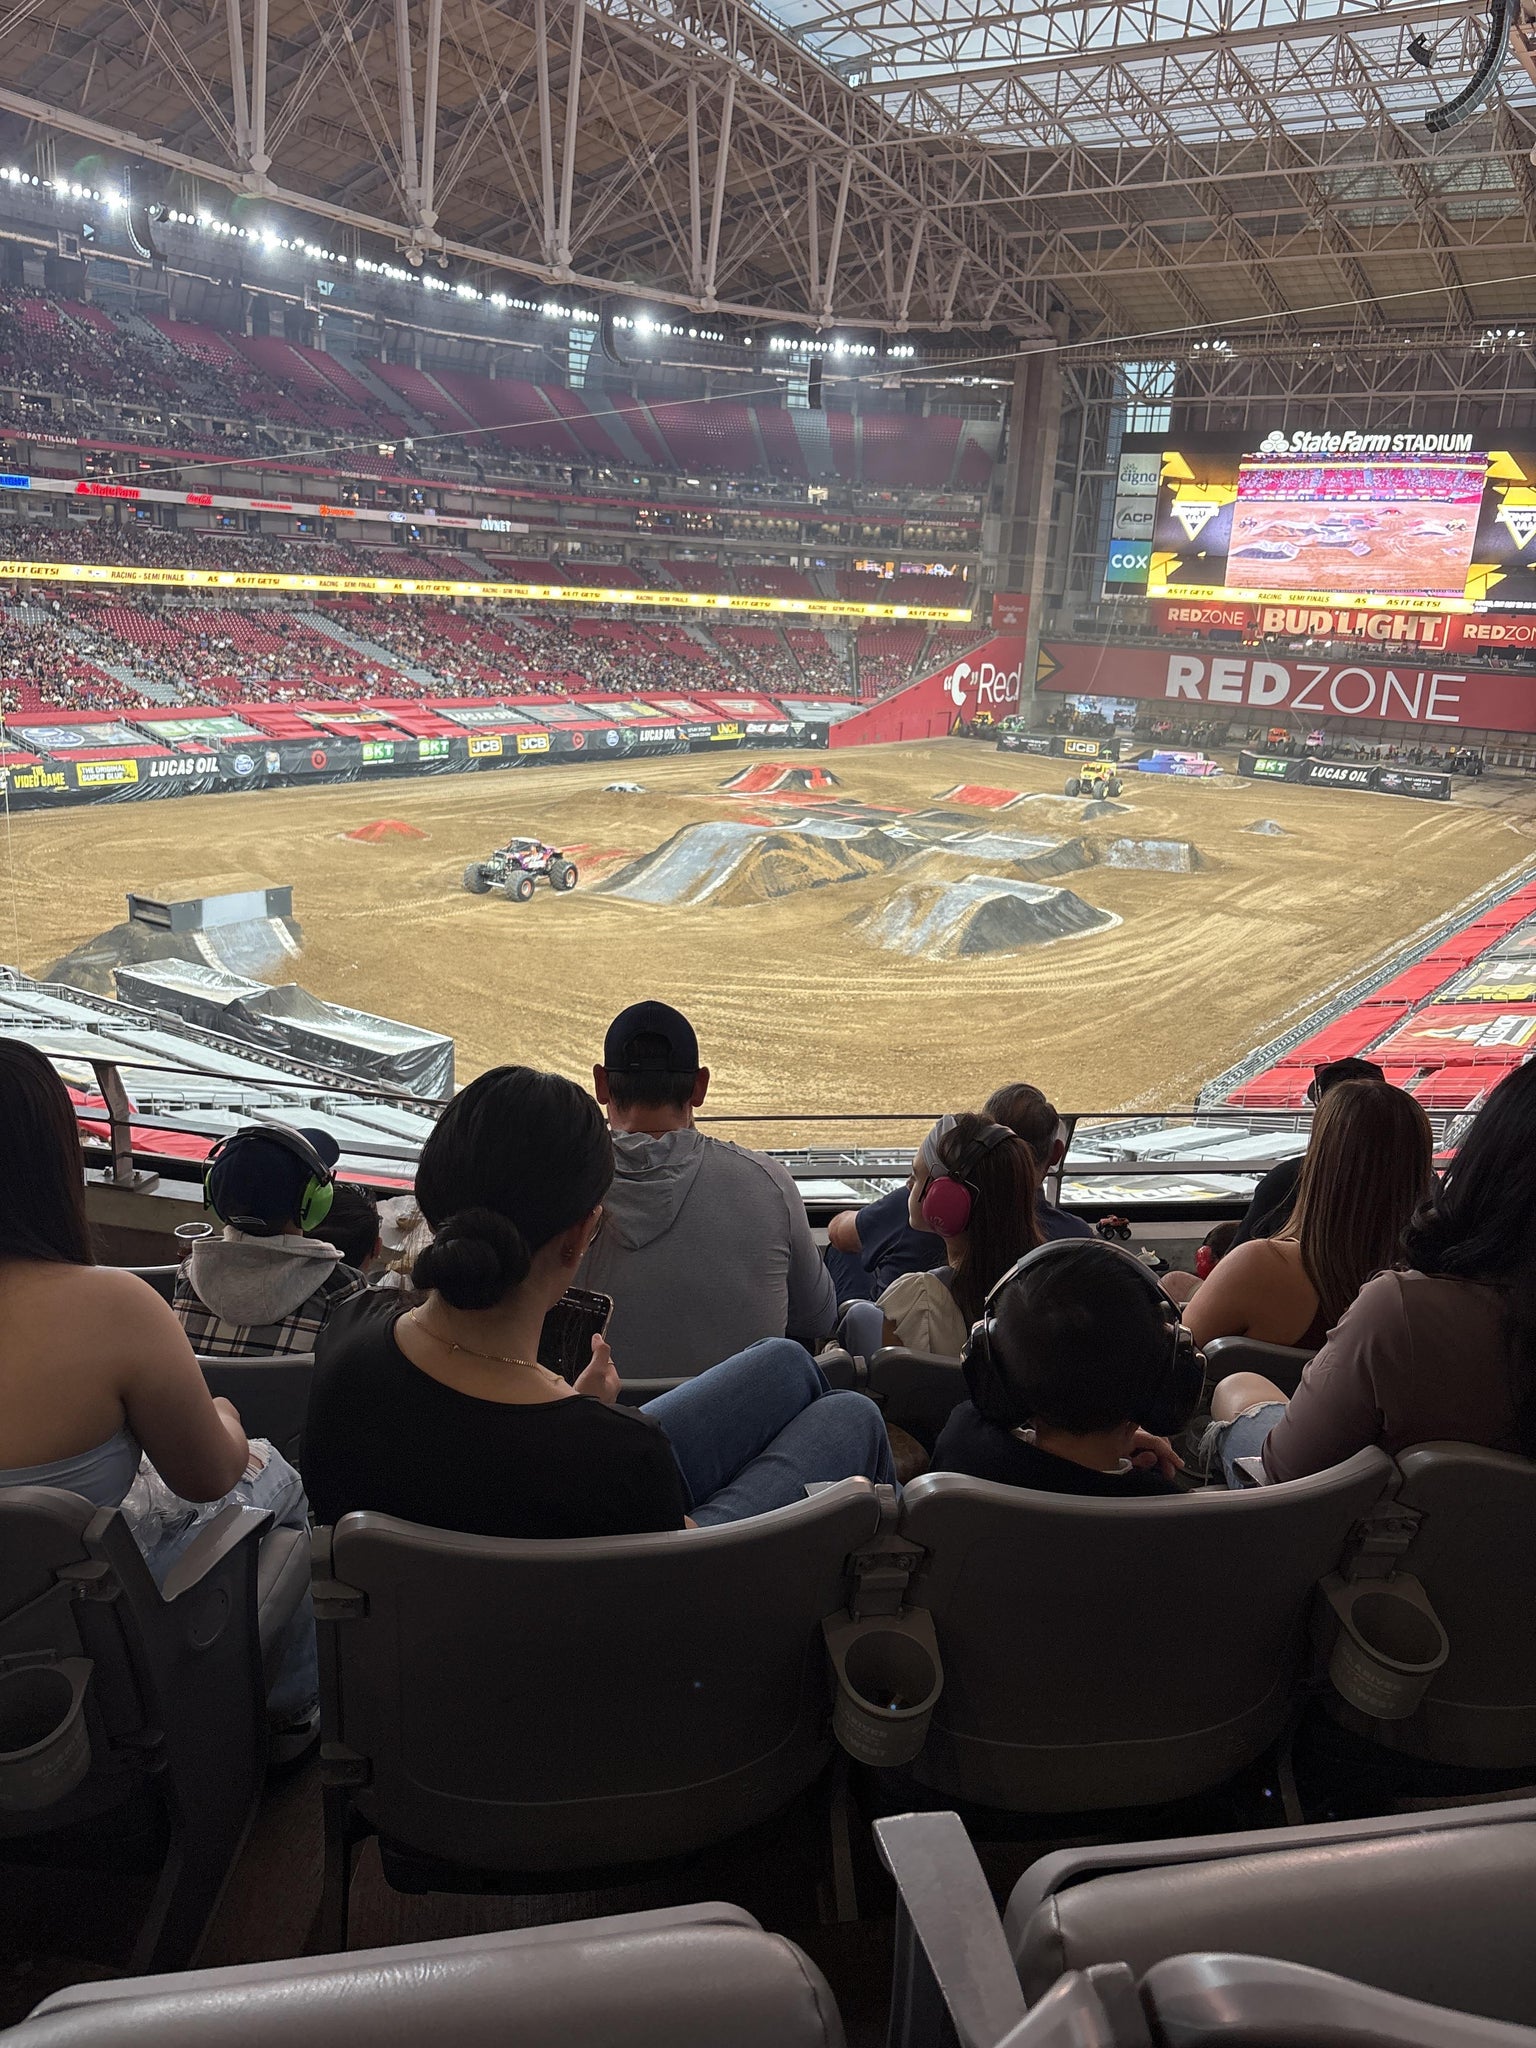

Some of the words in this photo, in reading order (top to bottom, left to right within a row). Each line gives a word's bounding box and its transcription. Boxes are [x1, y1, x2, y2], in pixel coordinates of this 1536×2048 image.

[27, 432, 42, 441] PAT
[44, 434, 78, 445] TILLMAN
[1392, 433, 1473, 452] STADIUM
[1120, 470, 1157, 486] cigna
[1121, 512, 1153, 523] ACP
[481, 518, 513, 533] AVNET
[1, 565, 15, 574] AS
[17, 566, 28, 574] IT
[30, 567, 59, 576] GETS!
[111, 571, 137, 580] RACING
[143, 572, 160, 581] SEMI
[161, 573, 185, 582] FINALS
[207, 575, 219, 583] AS
[235, 576, 247, 584] AS
[247, 577, 255, 585] IT
[257, 577, 280, 586] GETS!
[319, 580, 339, 588] RACING
[1257, 593, 1282, 601] RACING
[1288, 594, 1306, 602] SEMI
[1306, 595, 1330, 603] FINALS
[1354, 597, 1367, 605] AS
[1400, 599, 1411, 607] IT
[1412, 600, 1441, 608] GETS!
[1262, 607, 1334, 635] BUD
[1336, 610, 1442, 643] LIGHT
[977, 662, 1022, 704] Red
[639, 729, 664, 742] LUCAS
[664, 728, 676, 740] OIL
[419, 740, 449, 756] BKT
[472, 741, 500, 753] JCB
[520, 737, 547, 750] JCB
[1067, 742, 1096, 753] JCB
[363, 743, 394, 760] BKT
[31, 765, 44, 776] THE
[95, 764, 126, 774] ORIGINAL
[150, 758, 195, 778] LUCAS
[195, 756, 220, 774] OIL
[1254, 759, 1288, 772] BKT
[14, 774, 39, 789] VIDEO
[41, 772, 66, 787] GAME
[82, 773, 105, 782] SUPER
[106, 771, 125, 781] GLUE
[1310, 765, 1348, 782] LUCAS
[1349, 768, 1369, 784] OIL
